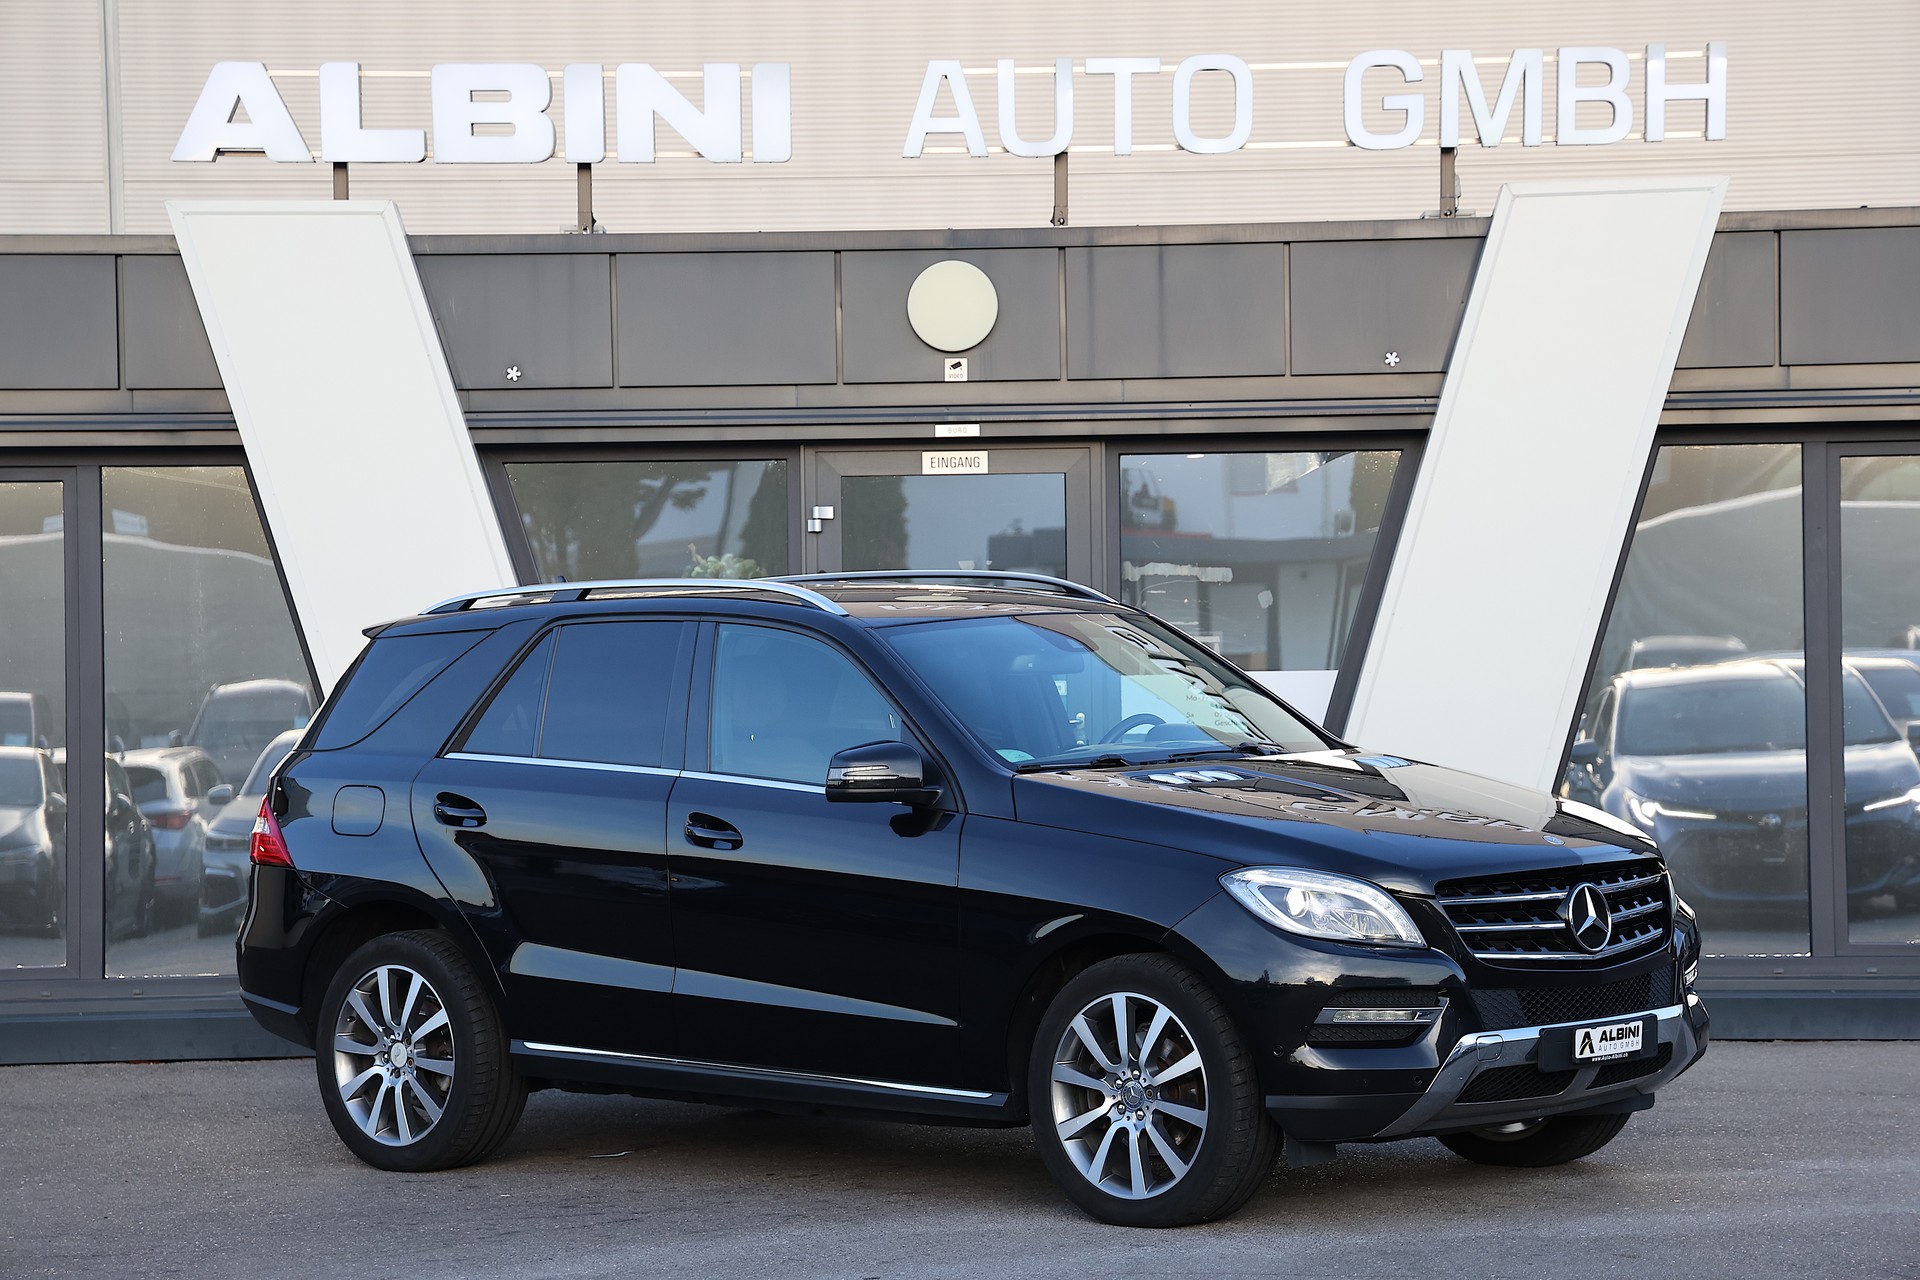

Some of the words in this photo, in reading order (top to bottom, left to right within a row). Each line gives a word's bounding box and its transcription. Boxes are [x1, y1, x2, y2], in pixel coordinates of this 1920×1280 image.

[170, 61, 793, 164] ALBINI
[902, 53, 1254, 158] AUTO
[1343, 41, 1729, 150] GMBH
[930, 456, 981, 469] EINGANG
[1599, 1025, 1640, 1043] ALBINI
[1620, 1040, 1640, 1049] GMBH
